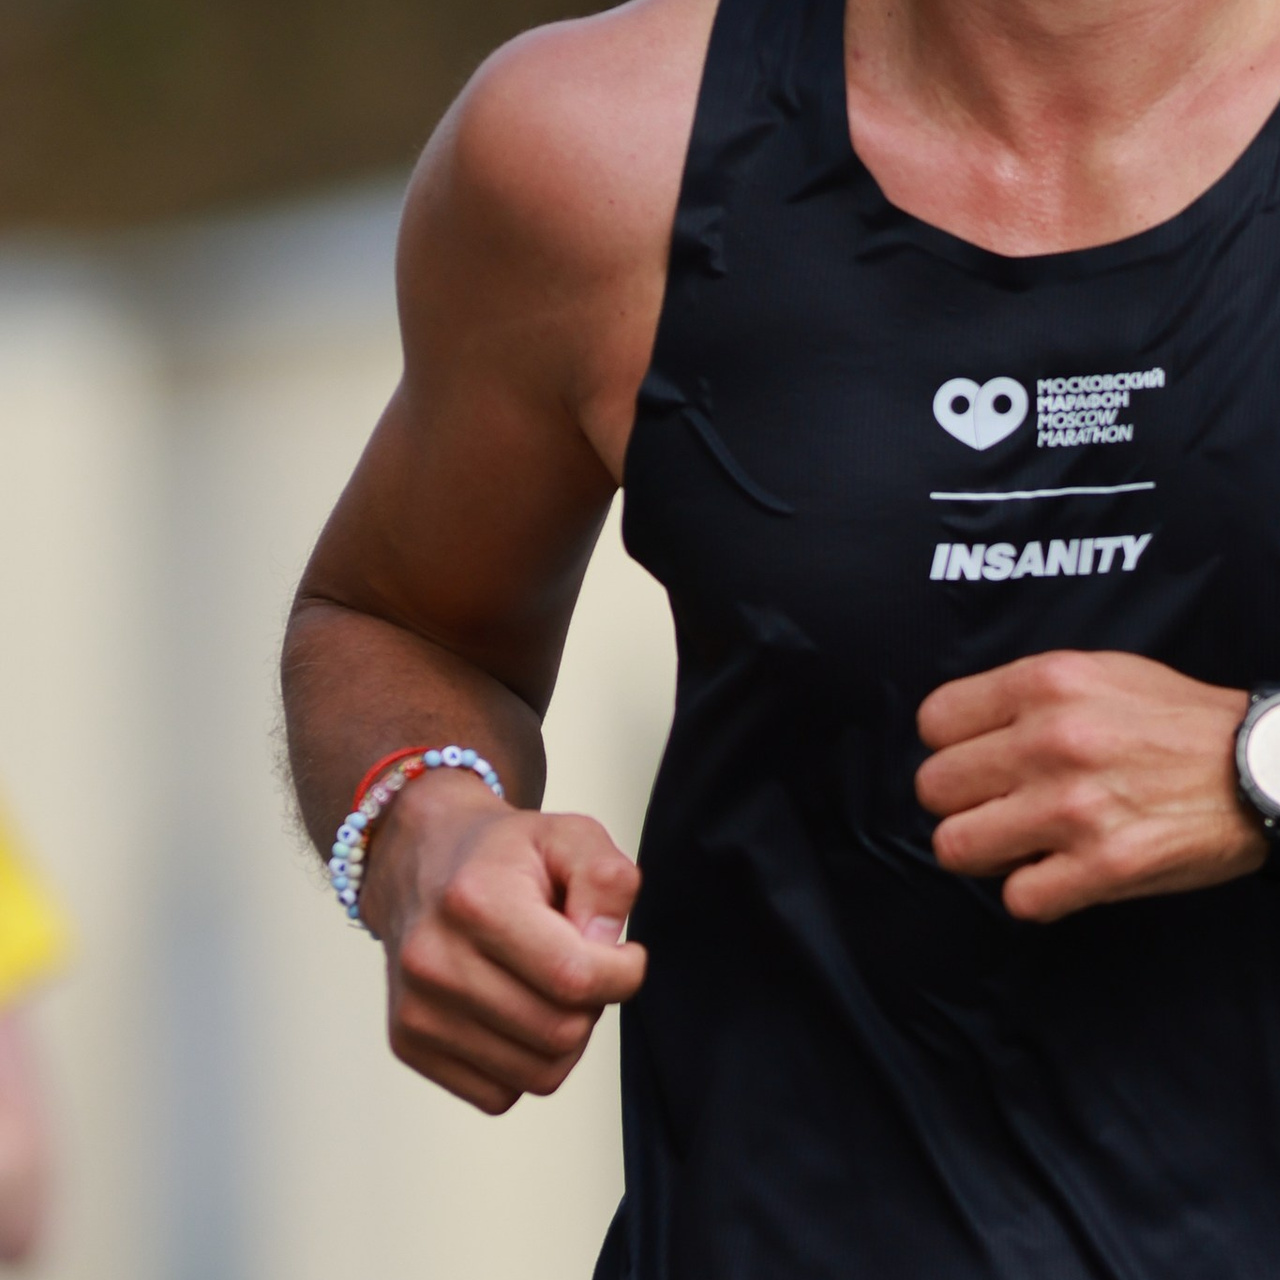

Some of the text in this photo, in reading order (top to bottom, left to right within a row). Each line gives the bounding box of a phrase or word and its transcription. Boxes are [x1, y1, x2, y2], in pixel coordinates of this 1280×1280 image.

[1037, 367, 1165, 395] МОСКОВСКИЙ
[1037, 391, 1129, 412] МАРАФОН
[1037, 408, 1118, 430] MOSCOW
[1037, 424, 1133, 448] MARATHON
[929, 533, 1153, 581] INSANITY
